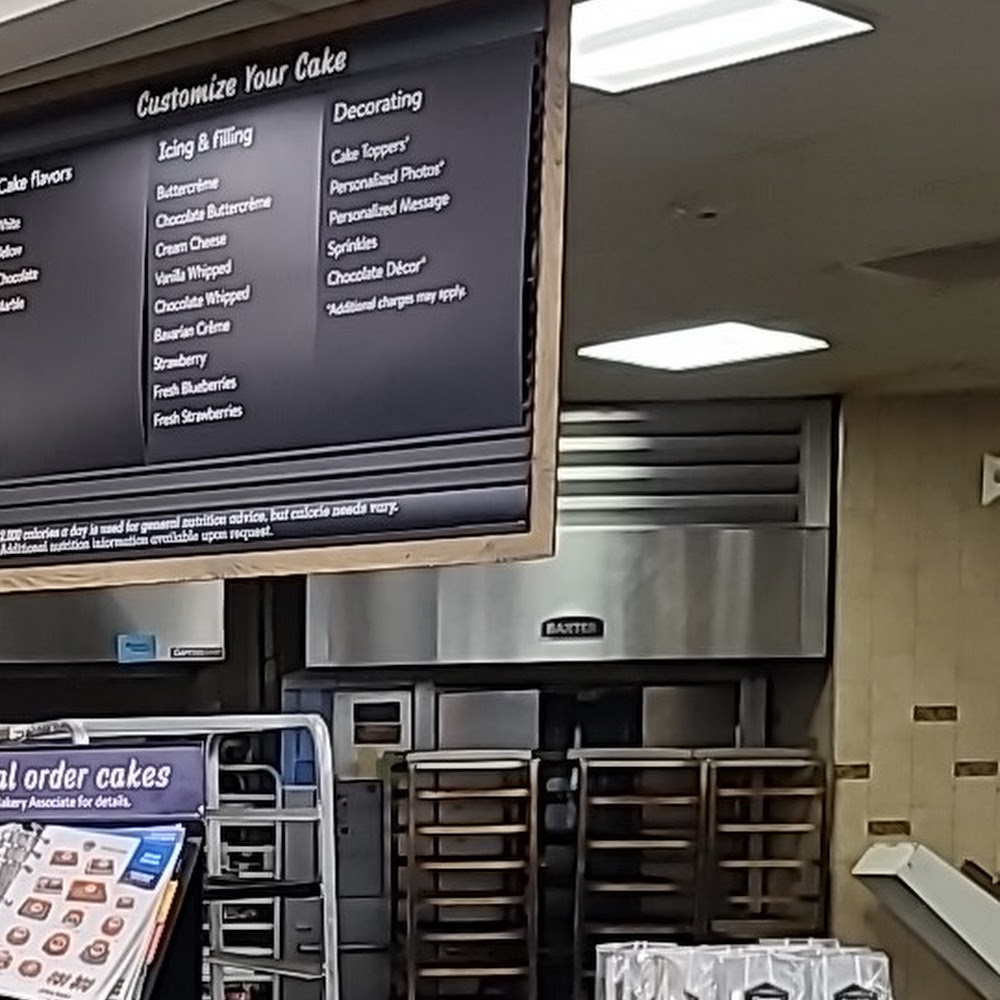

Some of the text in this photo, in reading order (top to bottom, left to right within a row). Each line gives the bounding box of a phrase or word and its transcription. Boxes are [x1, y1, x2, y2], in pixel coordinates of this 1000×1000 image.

[136, 46, 347, 118] Customize Your Cake
[333, 89, 423, 123] Decorating
[157, 140, 193, 161] Icing
[198, 132, 210, 152] &
[331, 148, 359, 164] Cake
[330, 169, 398, 195] Personalized
[155, 208, 205, 228] Chocolate
[329, 193, 450, 226] Personalized Message
[155, 234, 227, 257] Cream Cheese
[328, 235, 378, 259] Sprinkles
[155, 259, 232, 285] Vanilla Whipped
[327, 266, 383, 285] Chocolate
[154, 285, 250, 314] Chocolate Whipped
[378, 293, 414, 309] charges
[416, 291, 436, 304] may
[154, 325, 194, 342] Bavarian
[153, 353, 207, 370] Strawberry
[153, 376, 237, 399] Fresh Blueberries
[153, 404, 243, 427] Fresh Strawberries
[23, 527, 59, 540] calories
[61, 529, 68, 537] a
[70, 523, 88, 539] day
[90, 523, 98, 535] is
[100, 520, 124, 534] used
[126, 520, 139, 533] for
[141, 515, 180, 534] general
[182, 514, 226, 528] nutrition
[270, 509, 289, 523] but
[291, 506, 330, 520] calorie
[332, 502, 367, 516] needs
[0, 541, 48, 556] Additional
[50, 539, 90, 552] nutrition
[92, 535, 149, 549] information
[150, 530, 198, 545] available
[202, 530, 228, 543] upon
[23, 758, 89, 791] order
[96, 758, 171, 789] cakes
[28, 795, 76, 809] Associate
[77, 794, 93, 808] for
